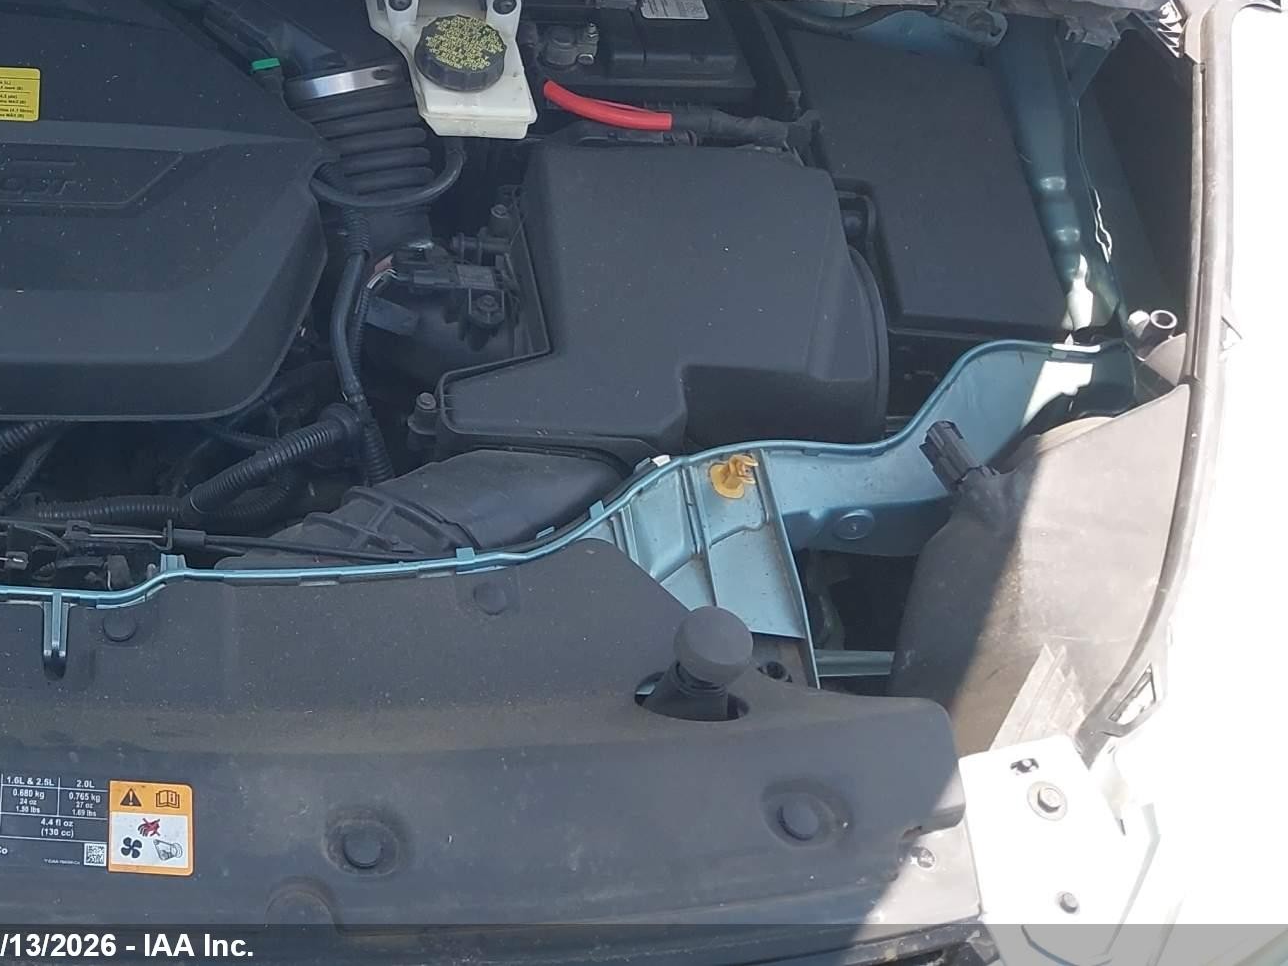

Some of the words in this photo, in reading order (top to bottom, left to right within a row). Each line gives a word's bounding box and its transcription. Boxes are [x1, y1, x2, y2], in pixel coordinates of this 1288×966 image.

[7, 776, 25, 785] 1.6L
[27, 777, 34, 785] &
[36, 778, 55, 787] 2.5L
[76, 780, 95, 789] 2.0L
[12, 789, 33, 797] 0.680
[35, 791, 45, 800] kg
[68, 792, 90, 801] 0.765
[91, 794, 101, 803] kg
[40, 818, 54, 826] 4.4
